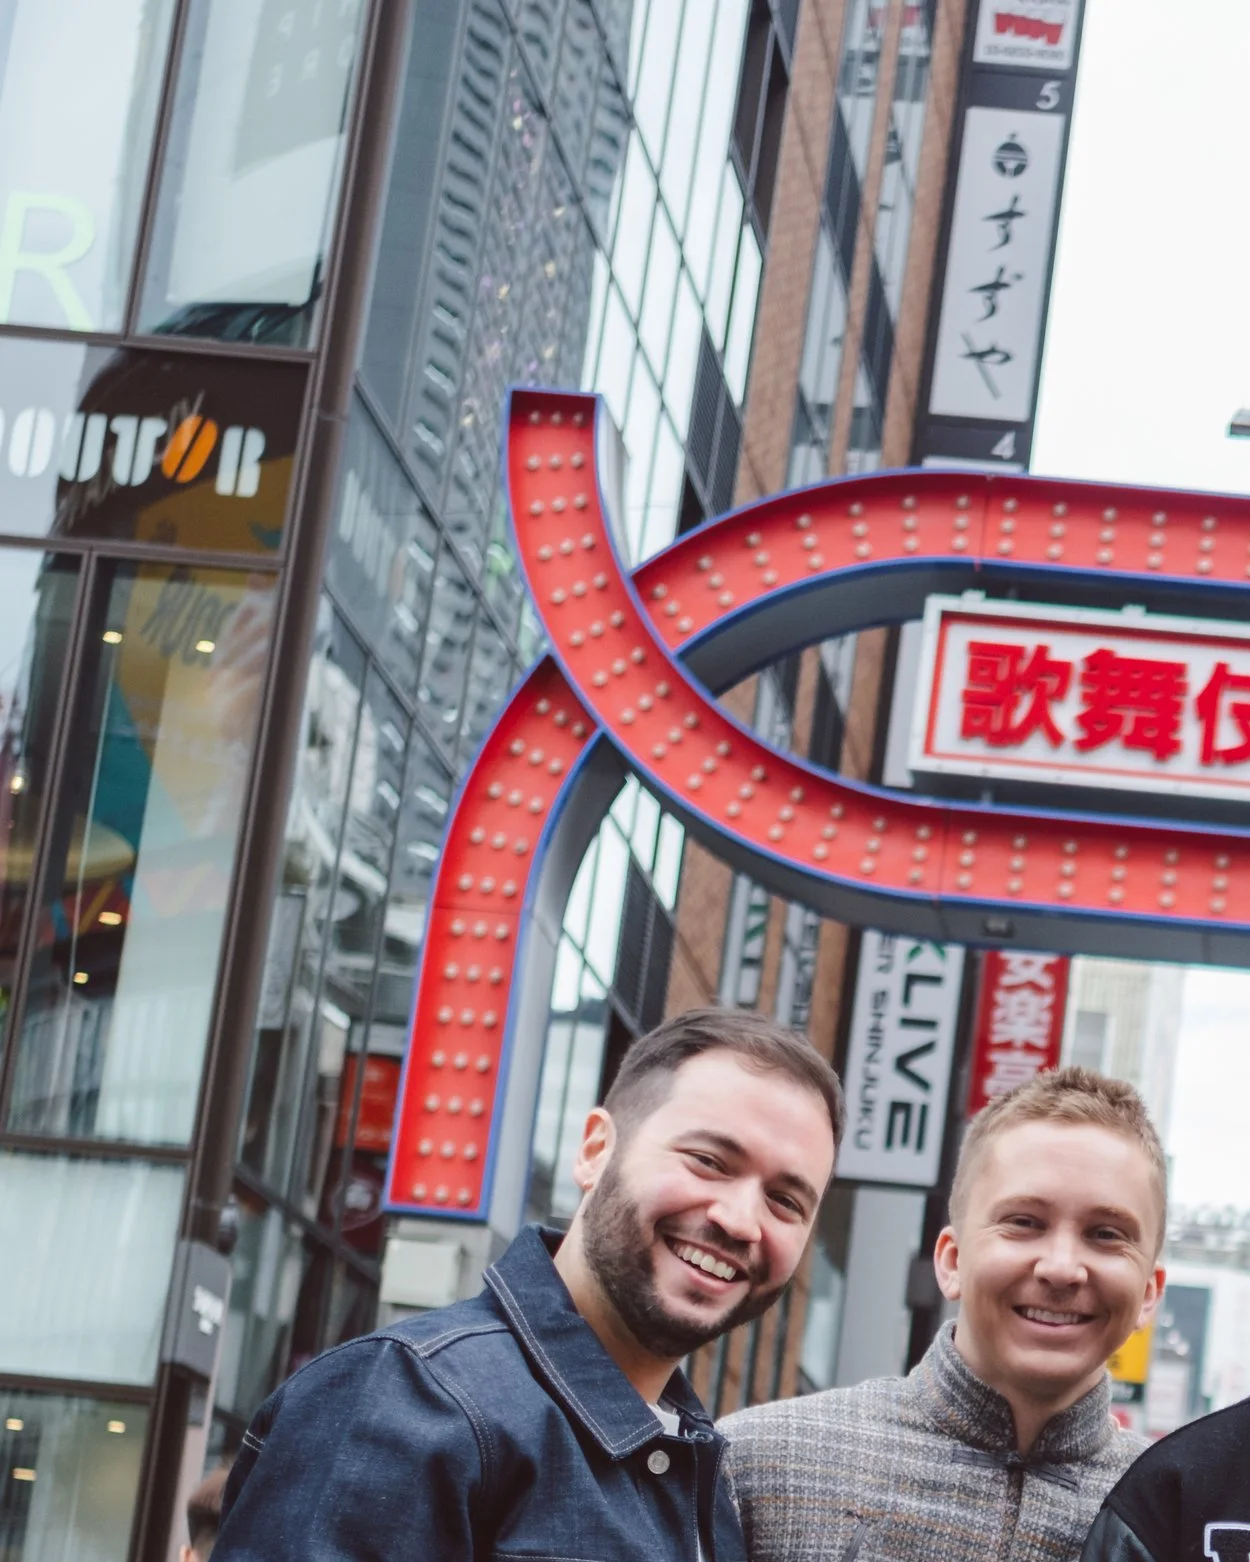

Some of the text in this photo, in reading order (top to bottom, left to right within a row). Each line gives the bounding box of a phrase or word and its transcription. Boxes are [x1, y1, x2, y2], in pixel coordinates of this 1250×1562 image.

[1035, 80, 1062, 111] 5
[957, 195, 1027, 400] すずや
[0, 405, 267, 498] OUTOR
[990, 430, 1017, 461] 4
[855, 990, 888, 1150] SHINJUKU
